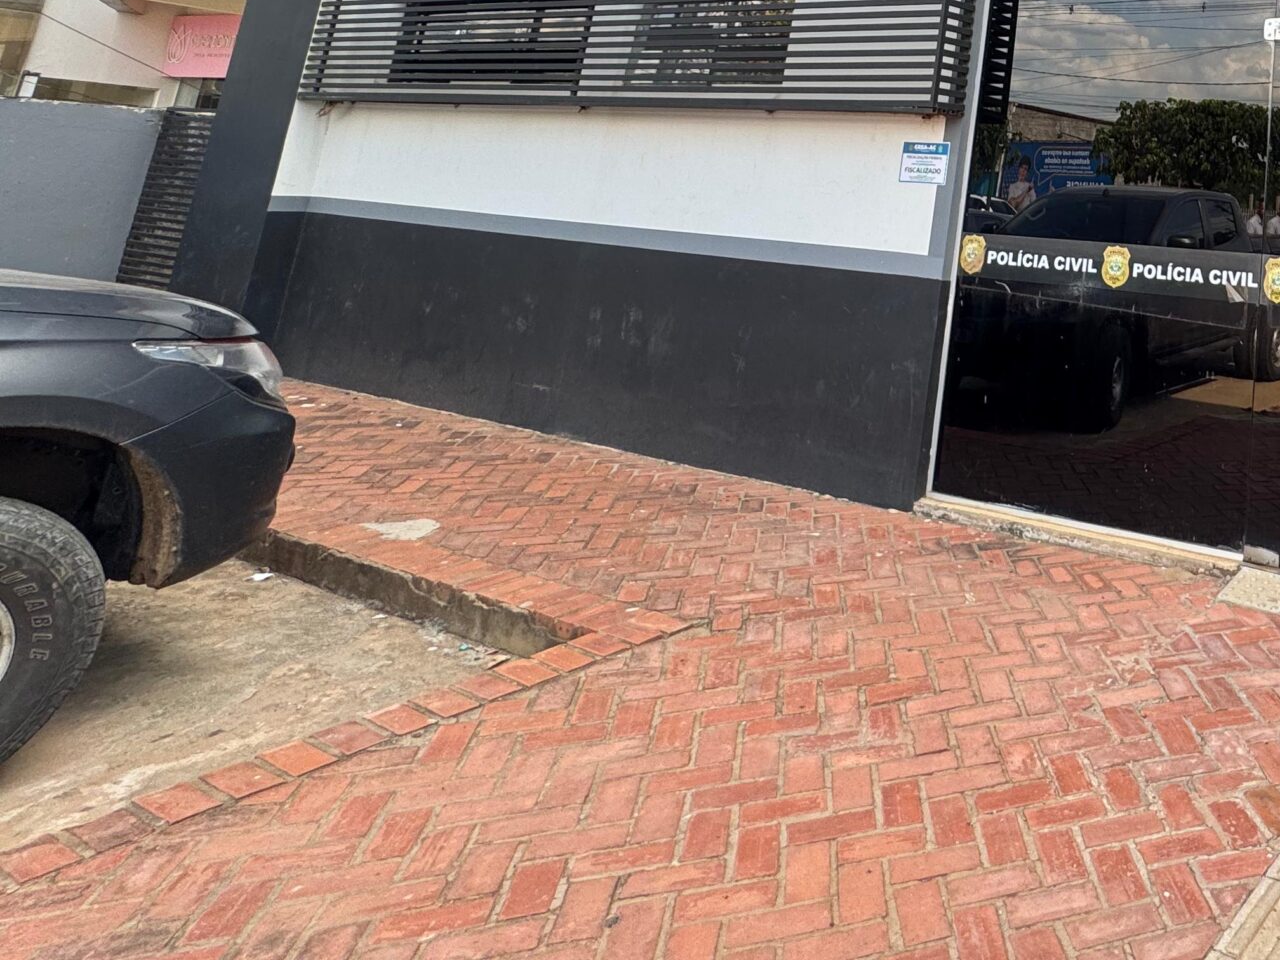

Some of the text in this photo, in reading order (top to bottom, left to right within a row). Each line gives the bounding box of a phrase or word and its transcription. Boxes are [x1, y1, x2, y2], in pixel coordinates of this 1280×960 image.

[904, 166, 942, 175] FISCALIZADO
[987, 246, 1097, 273] POLÍCIA CIVIL
[1132, 262, 1259, 288] POLÍCIA CIVIL
